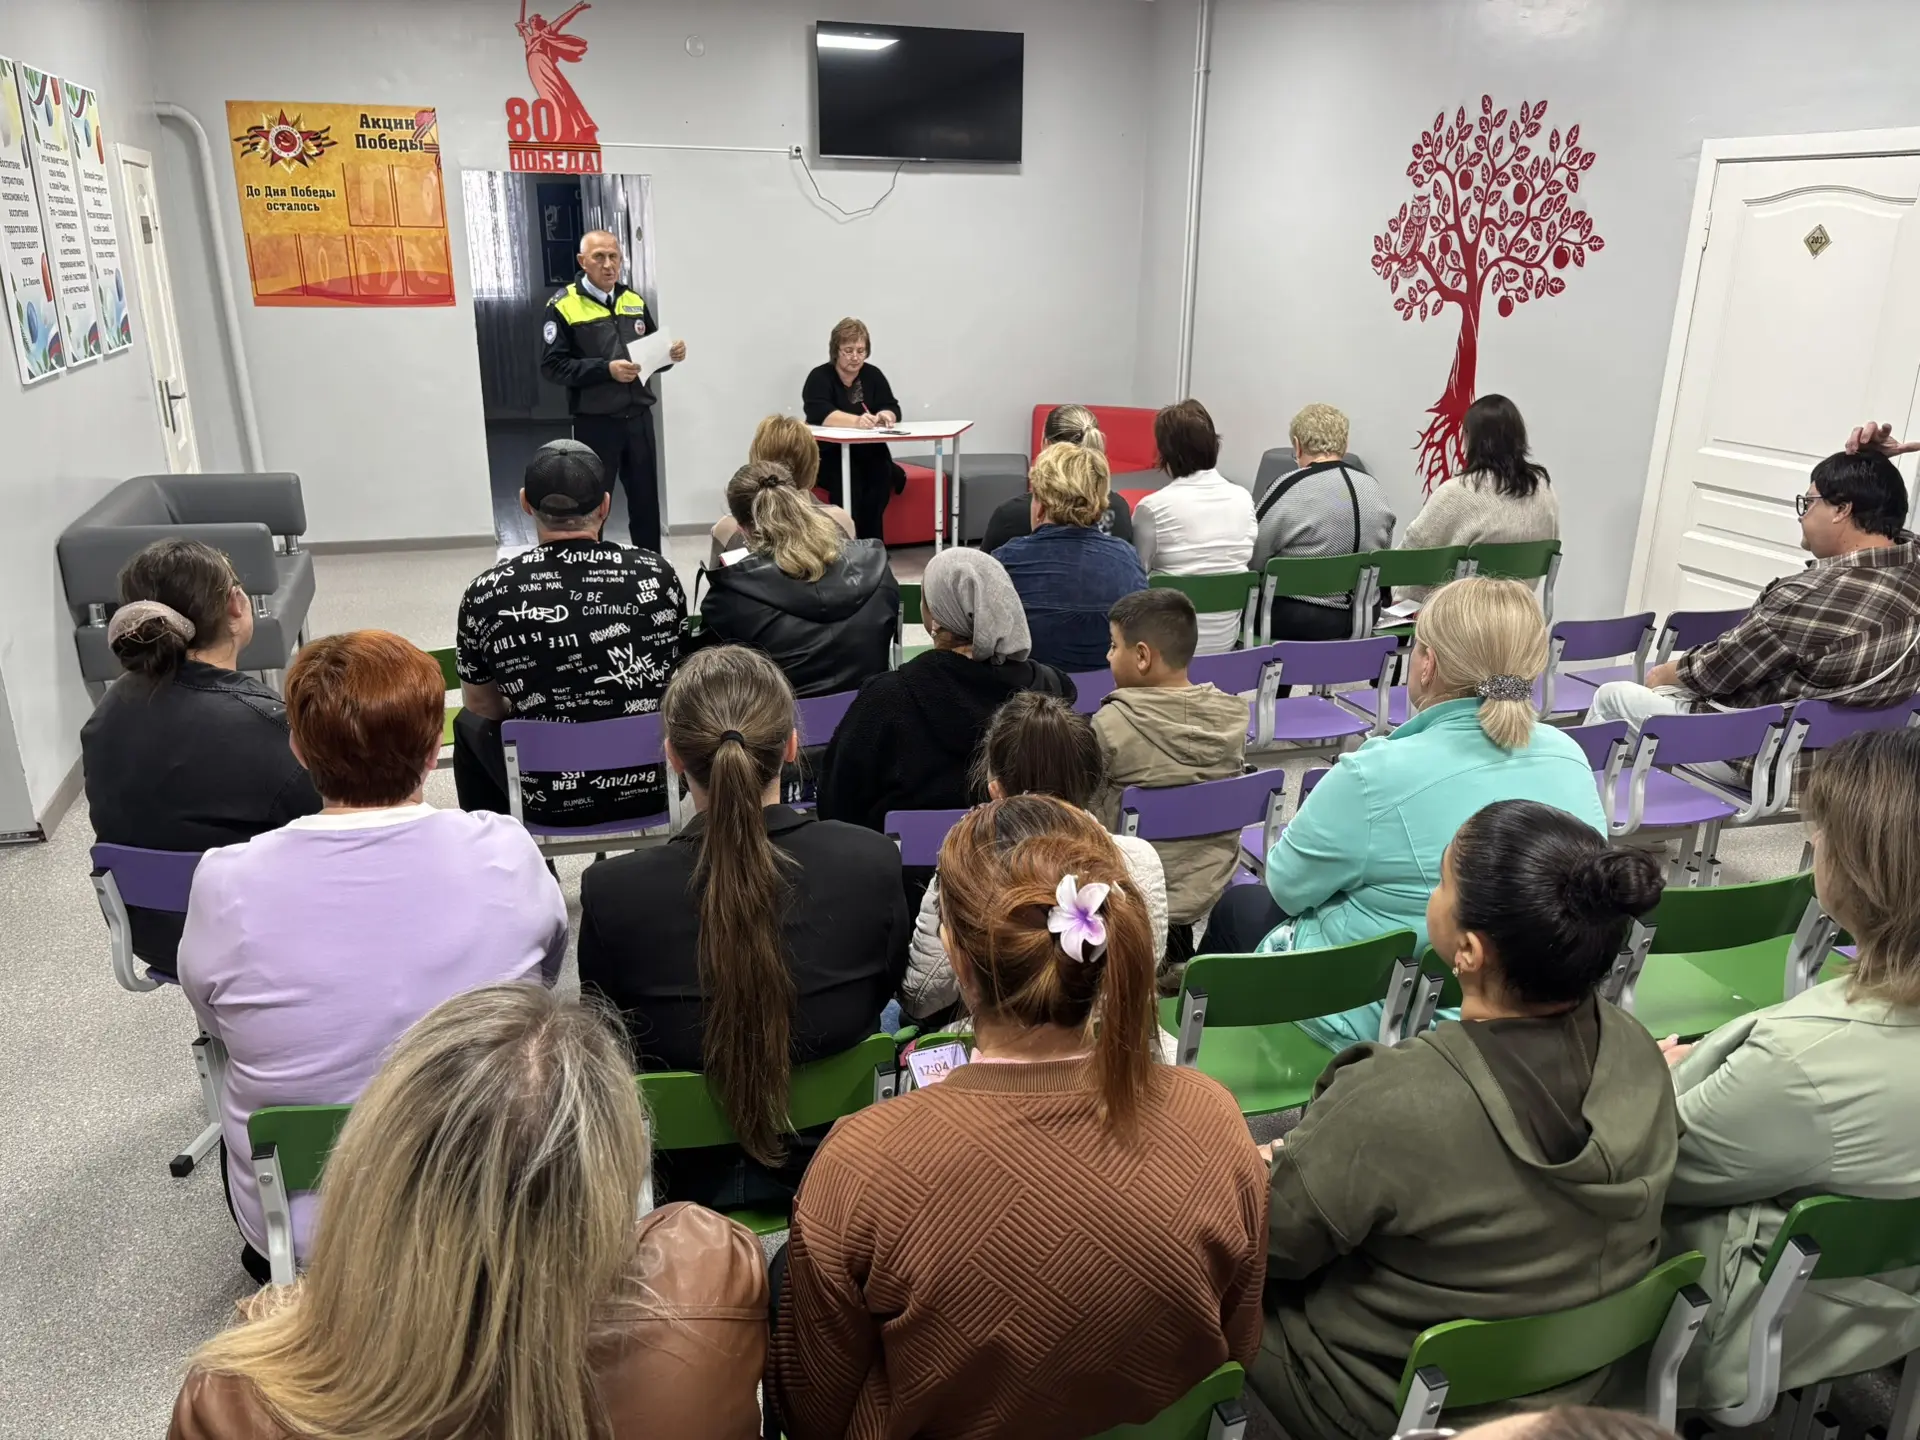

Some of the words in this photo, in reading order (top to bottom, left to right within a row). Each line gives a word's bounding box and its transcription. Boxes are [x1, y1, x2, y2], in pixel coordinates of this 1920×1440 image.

[505, 97, 558, 142] 80
[355, 133, 423, 152] Победы
[246, 185, 260, 198] До
[265, 185, 287, 198] Дня
[291, 185, 336, 199] Победы
[266, 202, 320, 212] осталось
[1811, 235, 1823, 244] 203
[556, 548, 622, 564] BRUTALITY
[637, 577, 660, 592] FEAR
[569, 590, 582, 601] TO
[587, 591, 603, 603] BE
[636, 590, 658, 604] LESS
[519, 633, 527, 644] A
[531, 631, 542, 642] IS
[548, 633, 579, 648] LIFE
[493, 634, 517, 654] TRIP
[552, 779, 577, 791] FEAR
[589, 770, 656, 789] BRUTALITY
[919, 1061, 950, 1076] 17:04
